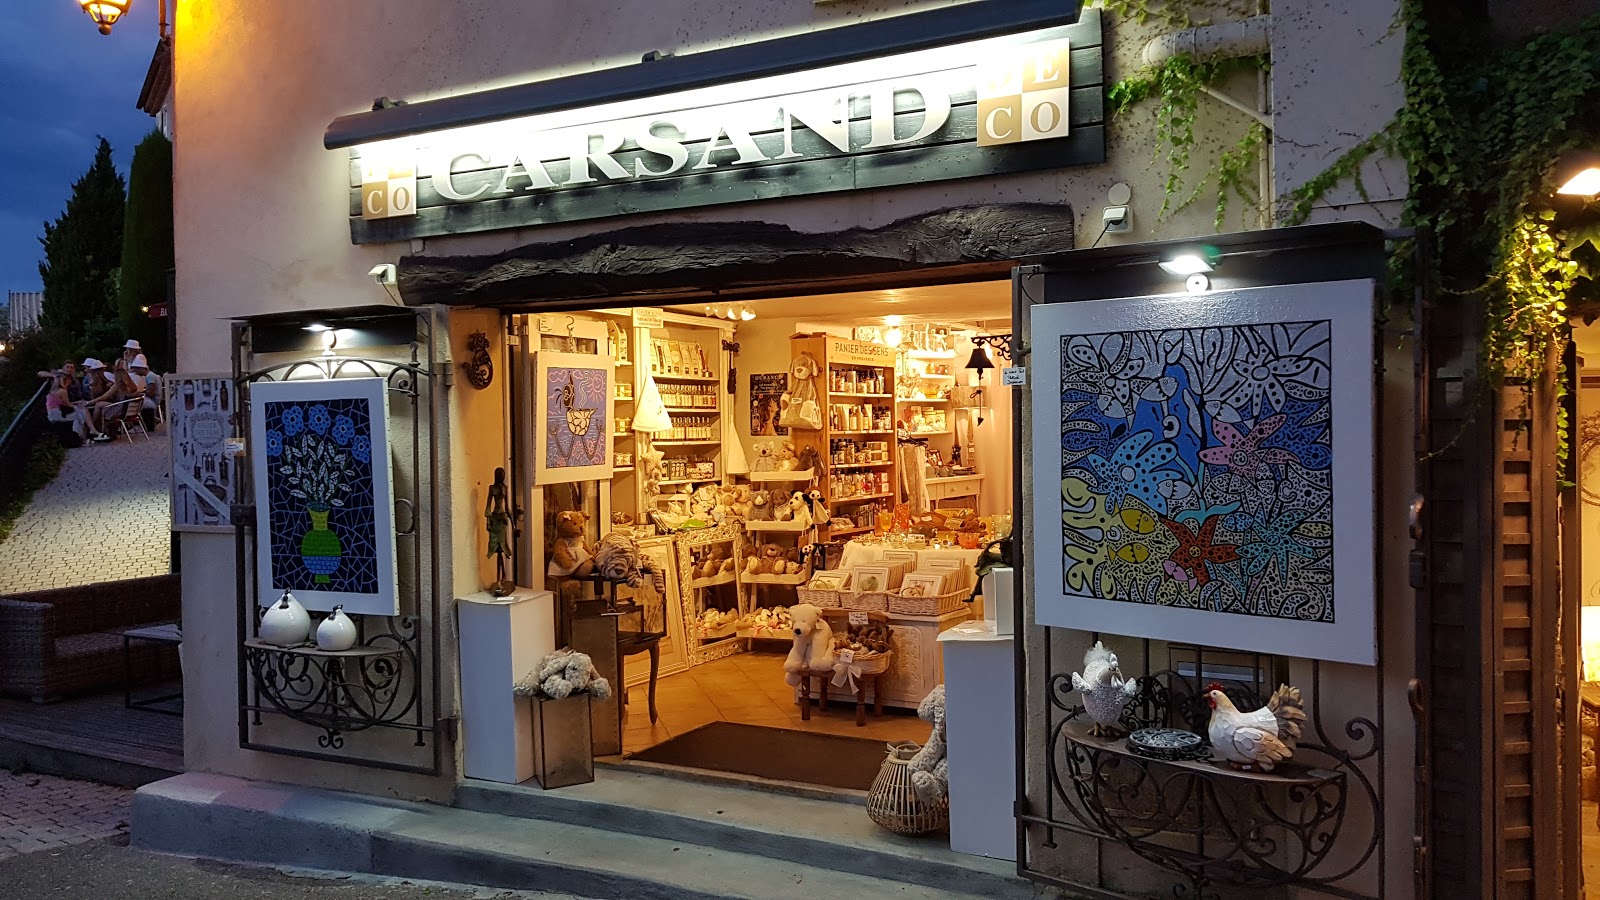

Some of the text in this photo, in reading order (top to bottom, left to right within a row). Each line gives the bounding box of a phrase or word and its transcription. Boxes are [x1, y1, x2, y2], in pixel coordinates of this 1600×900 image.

[985, 101, 1060, 139] CO
[432, 86, 953, 201] CARSAND
[366, 186, 410, 214] CO
[835, 343, 888, 356] PANIER DES SENS
